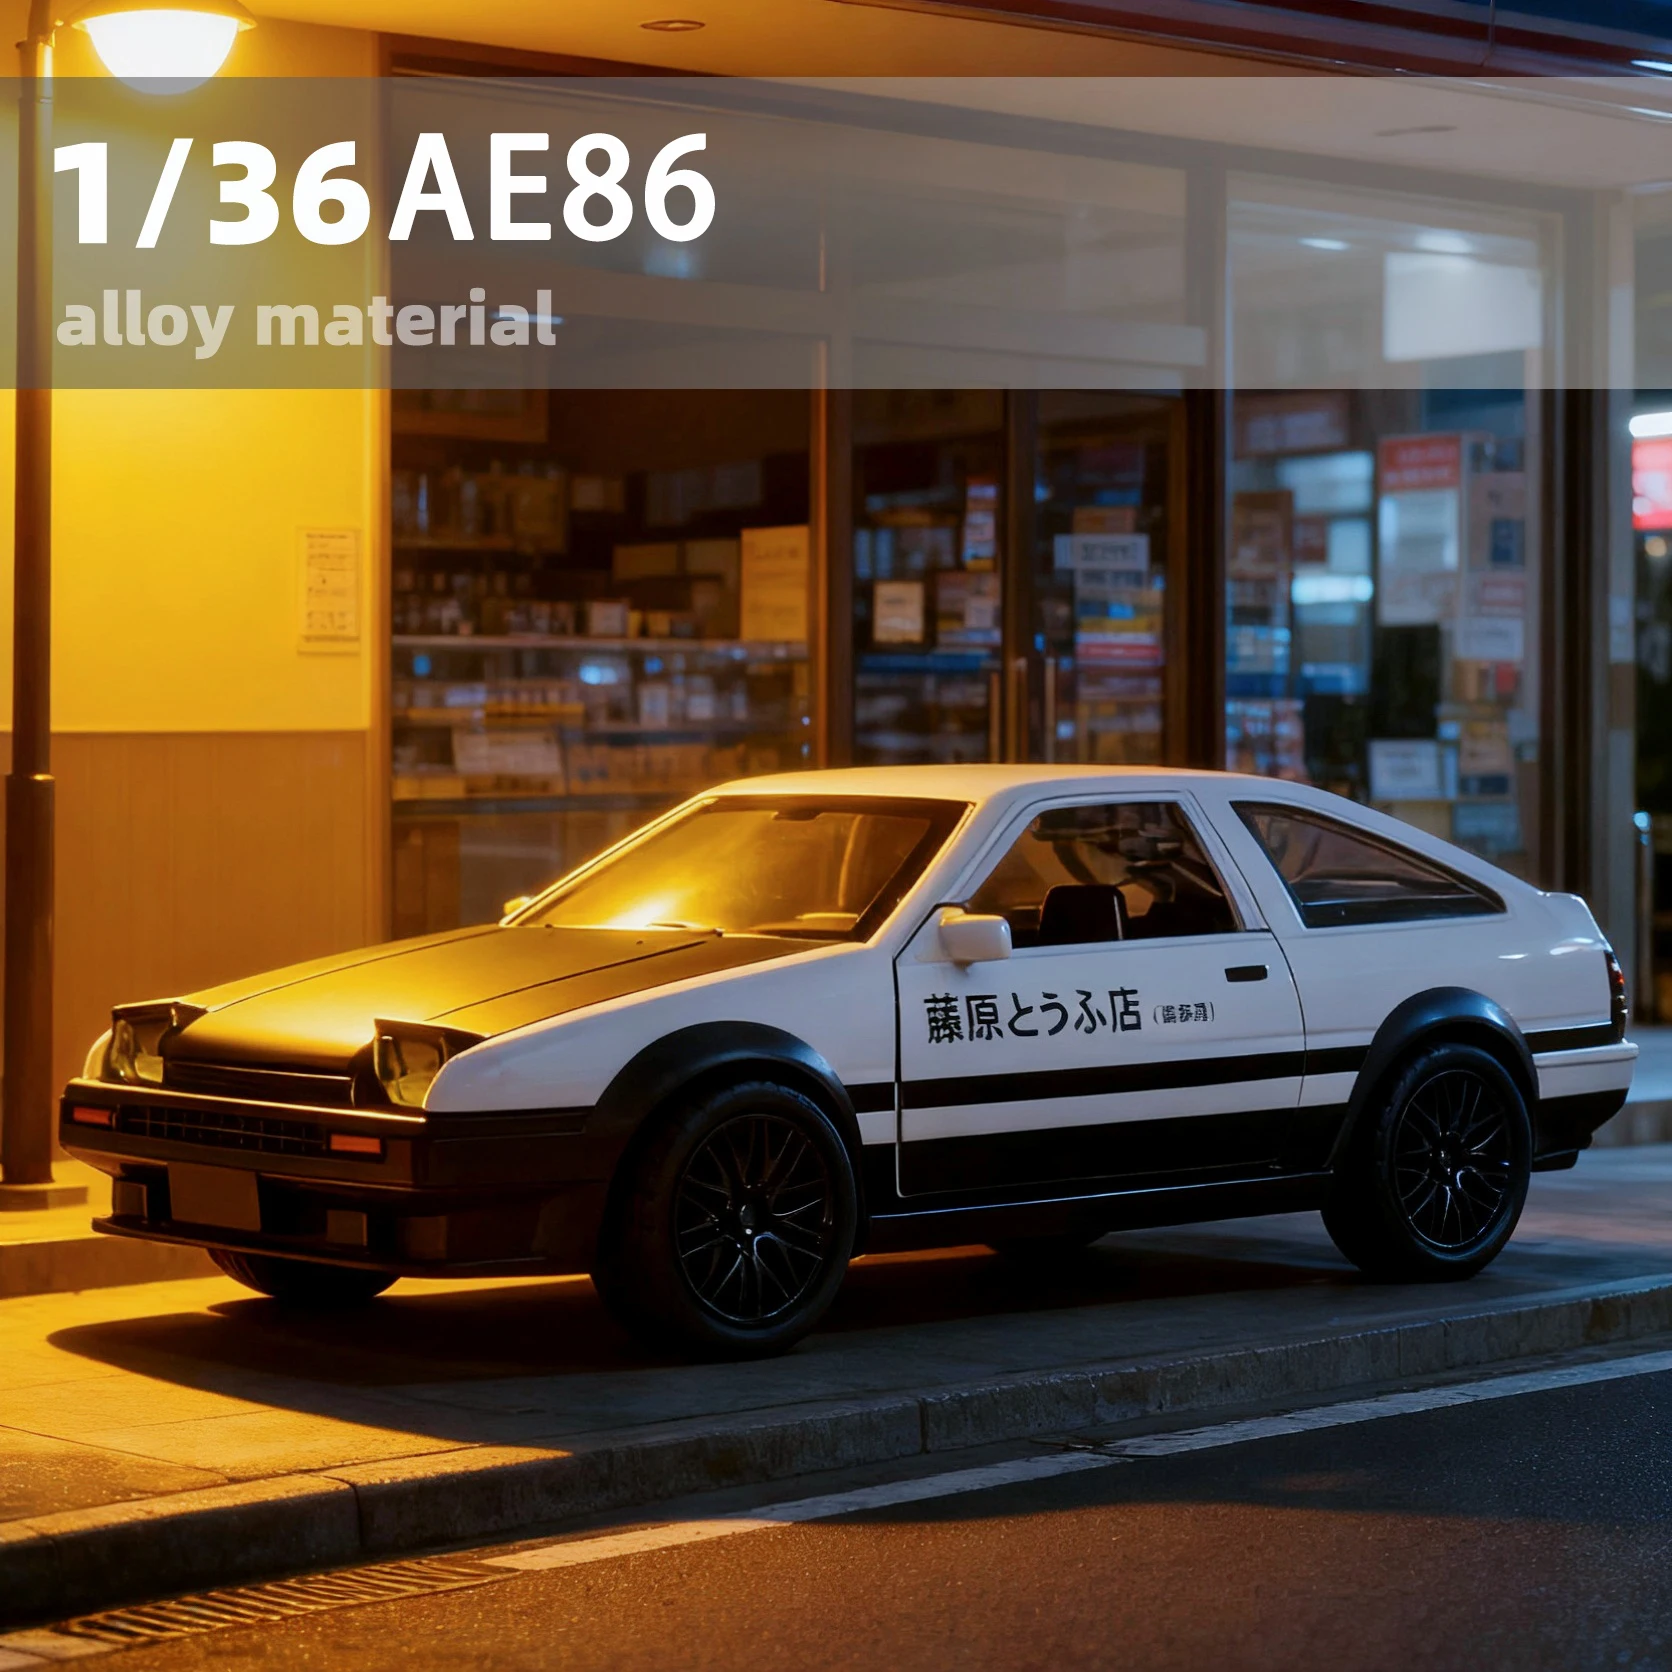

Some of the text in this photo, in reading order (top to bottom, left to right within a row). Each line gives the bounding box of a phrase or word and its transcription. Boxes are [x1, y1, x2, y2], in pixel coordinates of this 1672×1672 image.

[923, 987, 1142, 1044] 藤原とうふ店
